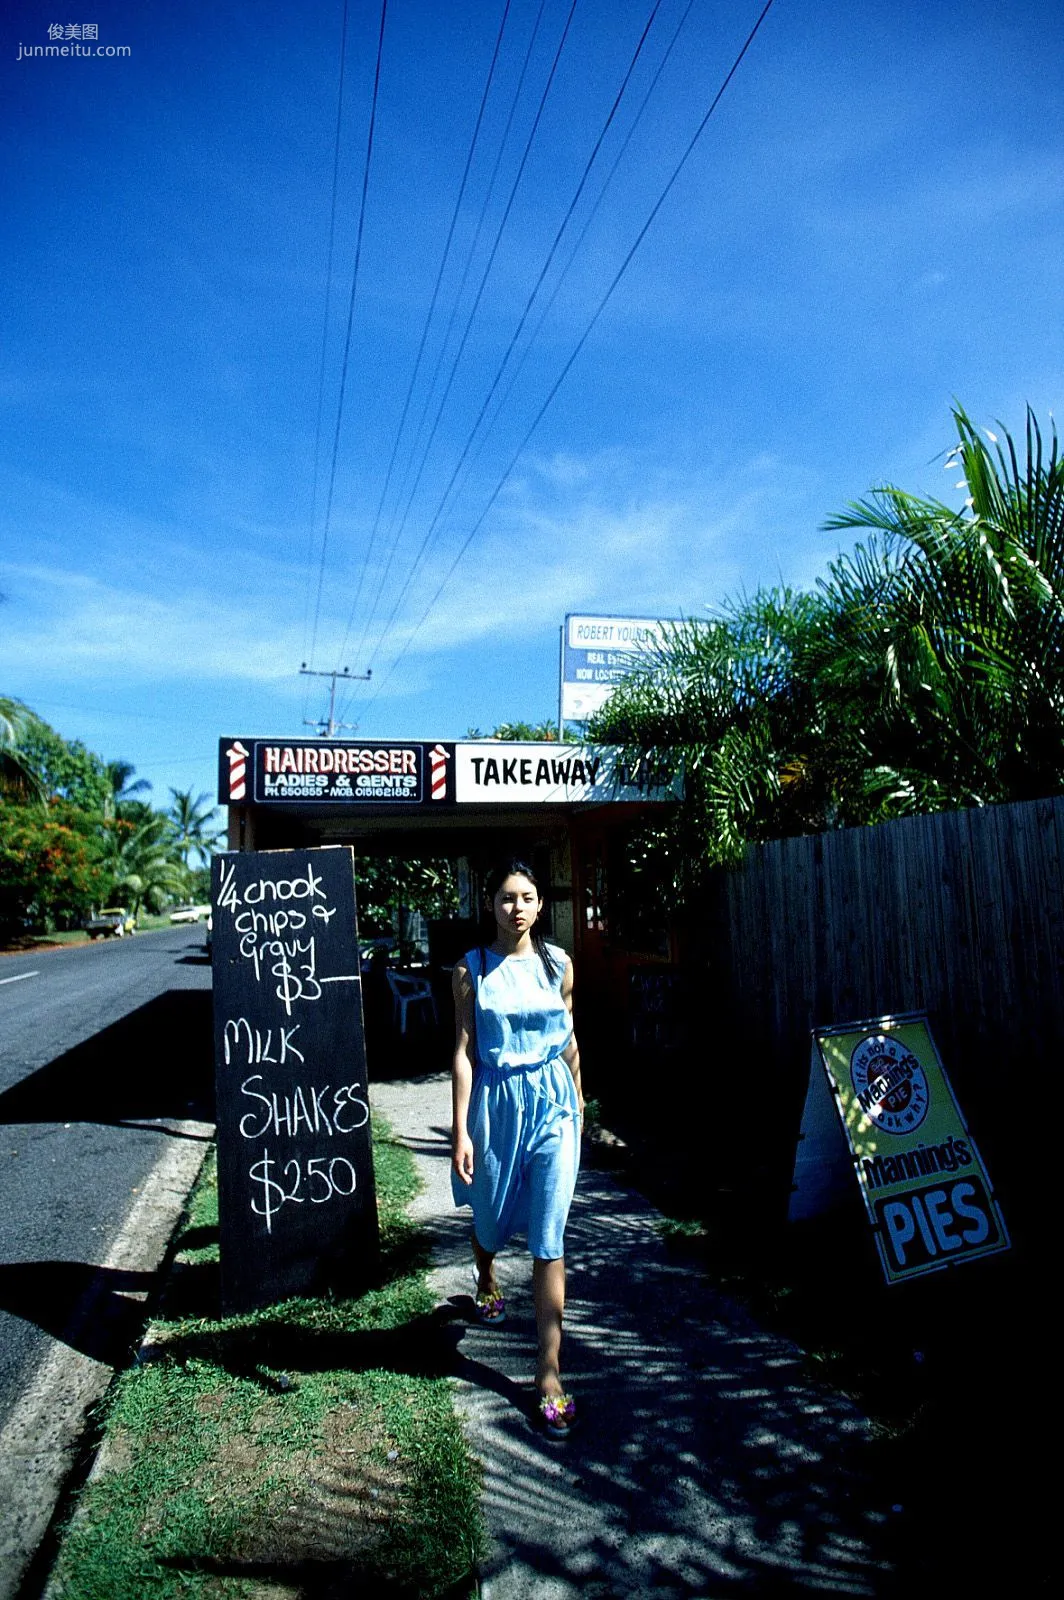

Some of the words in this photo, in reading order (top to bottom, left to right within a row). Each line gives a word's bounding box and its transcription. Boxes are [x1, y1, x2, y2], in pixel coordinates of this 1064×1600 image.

[577, 624, 614, 641] ROBERT
[264, 747, 417, 774] HAIRDRESSER
[471, 757, 600, 787] TAKEAWAY
[264, 774, 329, 787] LADIES
[335, 774, 351, 787] &
[356, 774, 417, 788] GENTS
[281, 787, 323, 797] 550855
[235, 908, 307, 937] chips
[224, 1018, 304, 1064] MILK
[867, 1042, 885, 1057] not
[239, 1075, 369, 1139] SHAKES
[887, 1086, 908, 1109] PIE
[862, 1136, 972, 1189] Manning's
[883, 1182, 989, 1265] PIES
